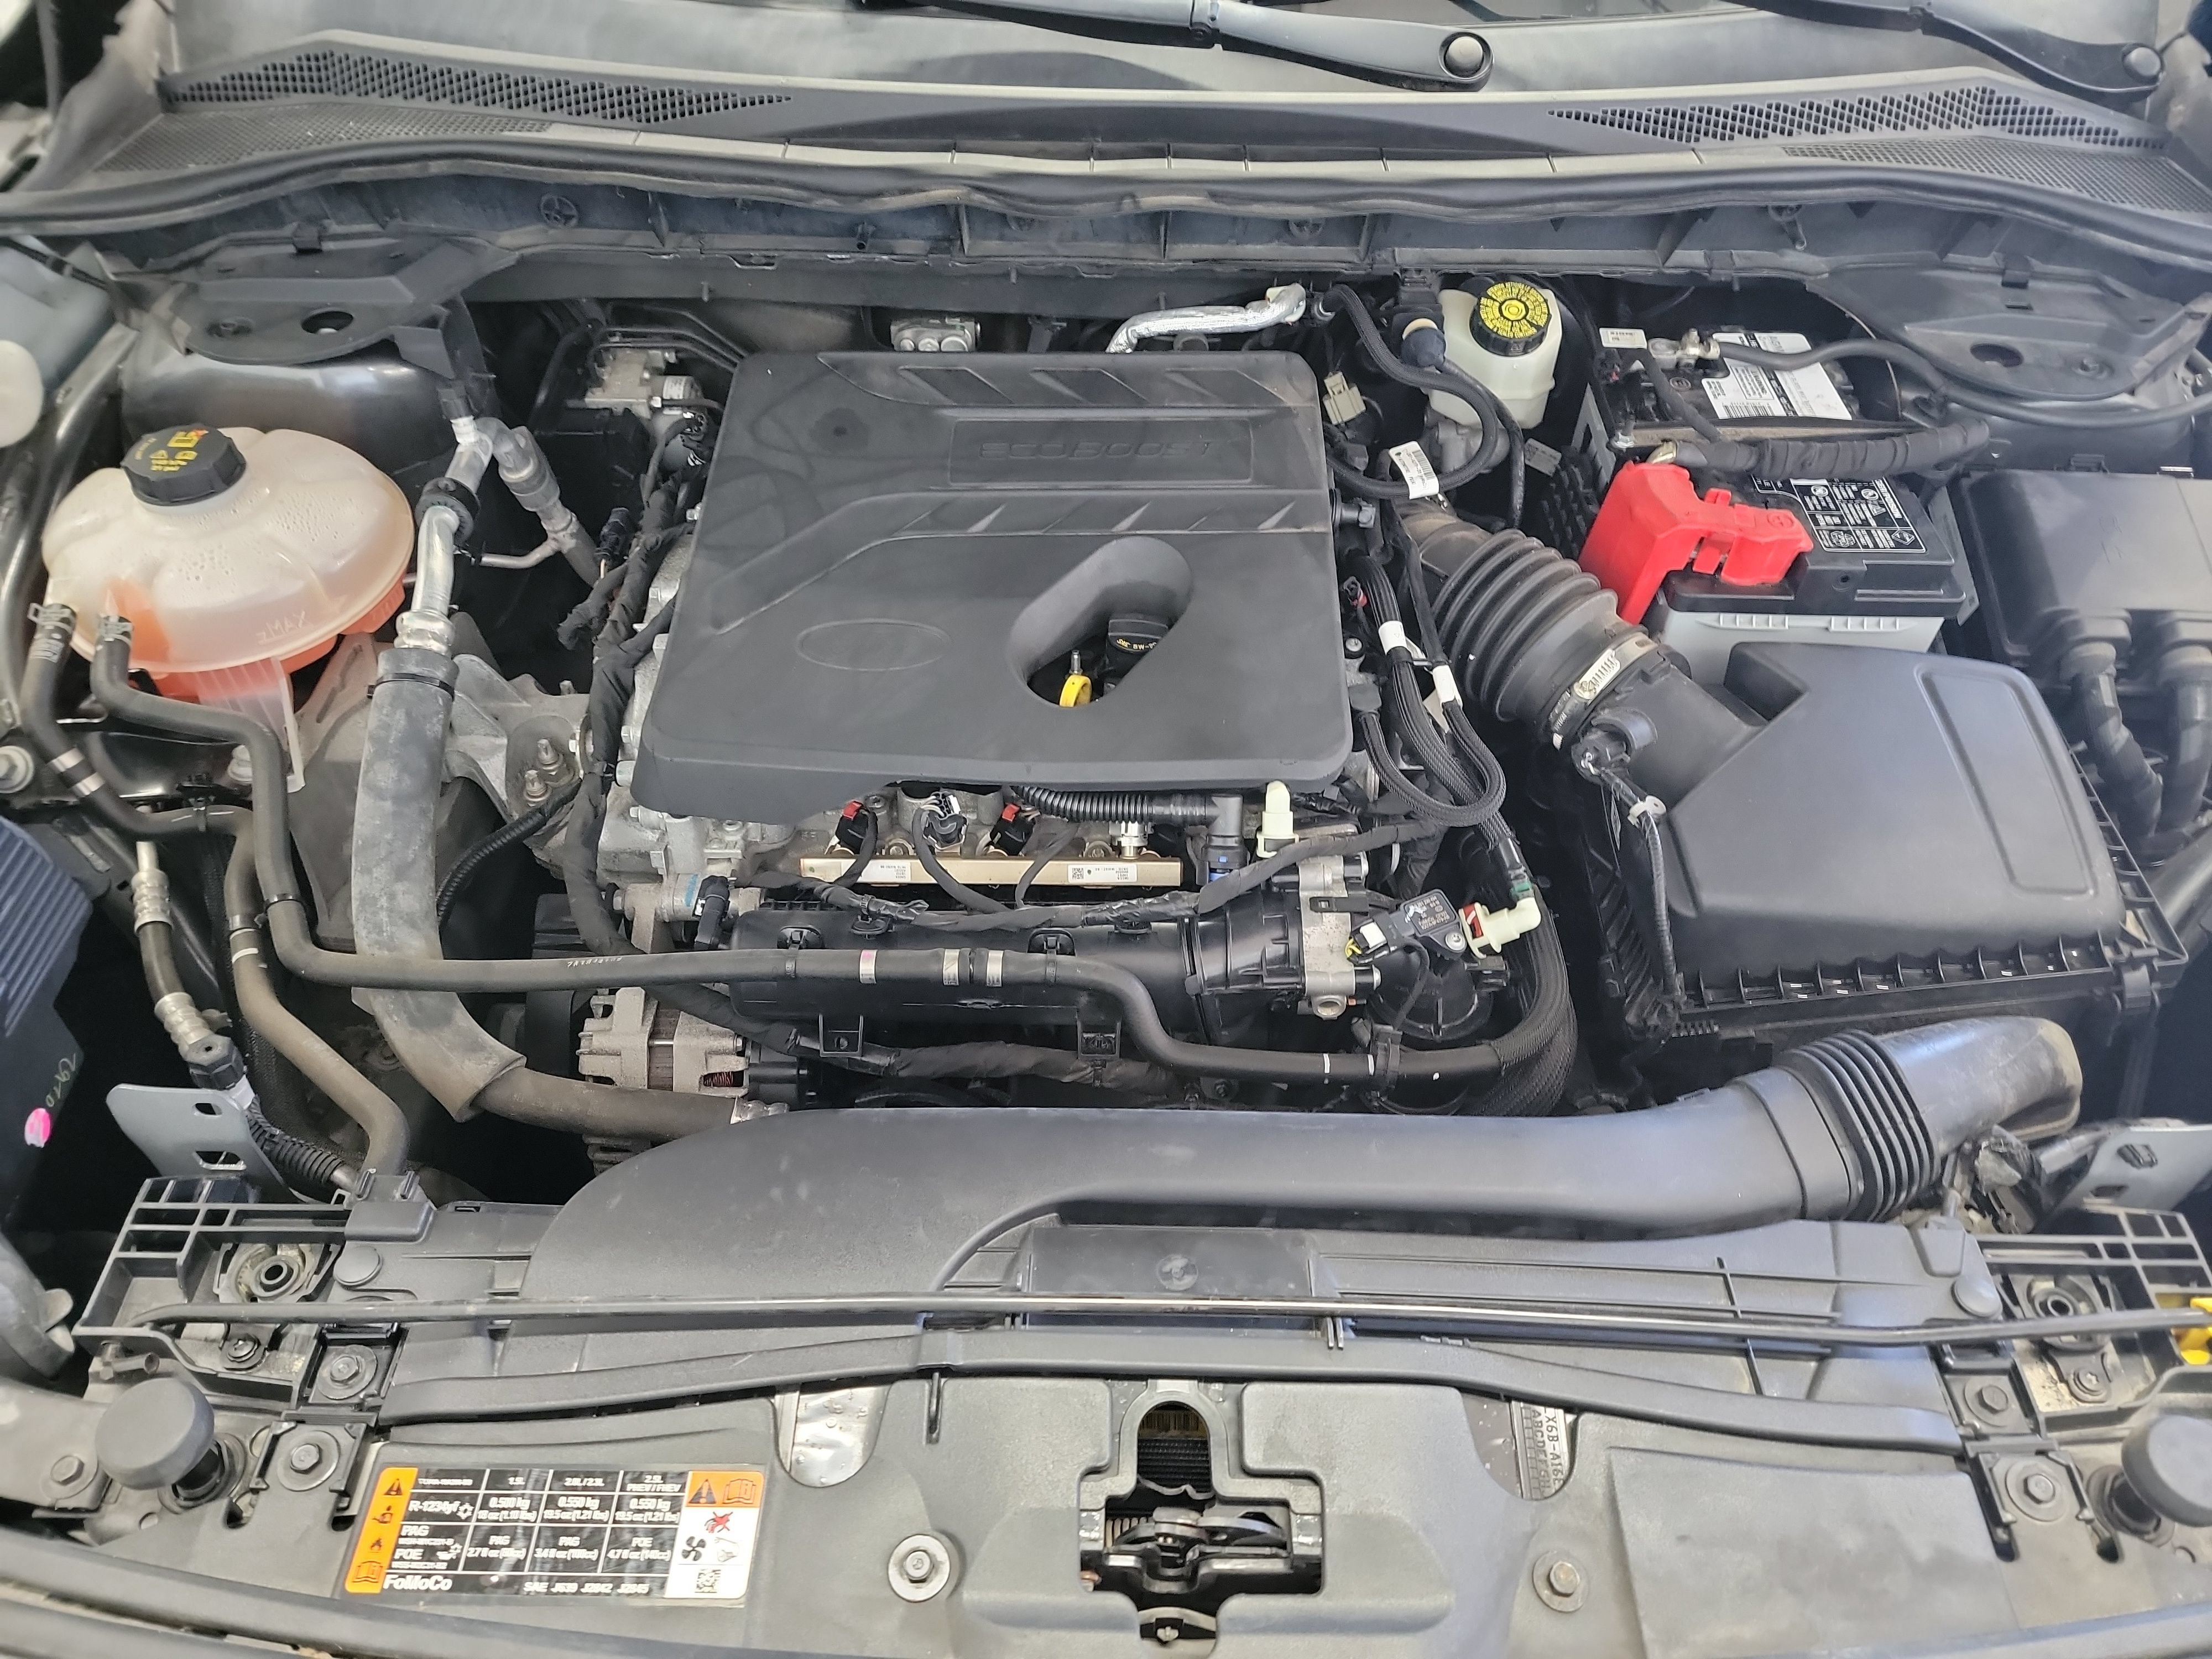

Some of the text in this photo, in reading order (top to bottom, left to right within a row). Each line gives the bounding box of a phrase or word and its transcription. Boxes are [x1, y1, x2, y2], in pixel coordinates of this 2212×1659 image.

[979, 441, 1215, 460] ECOBOOST
[266, 611, 306, 638] MAX
[408, 1500, 461, 1515] R-1234yf
[517, 1498, 531, 1510] kg
[586, 1497, 600, 1510] kg
[656, 1499, 671, 1511] kg
[401, 1525, 430, 1536] PAG
[489, 1535, 510, 1546] PAG
[559, 1536, 580, 1546] PAG
[632, 1537, 653, 1547] POE
[394, 1548, 424, 1559] POE
[383, 1575, 453, 1590] FoMoCo
[523, 1582, 549, 1592] SAE
